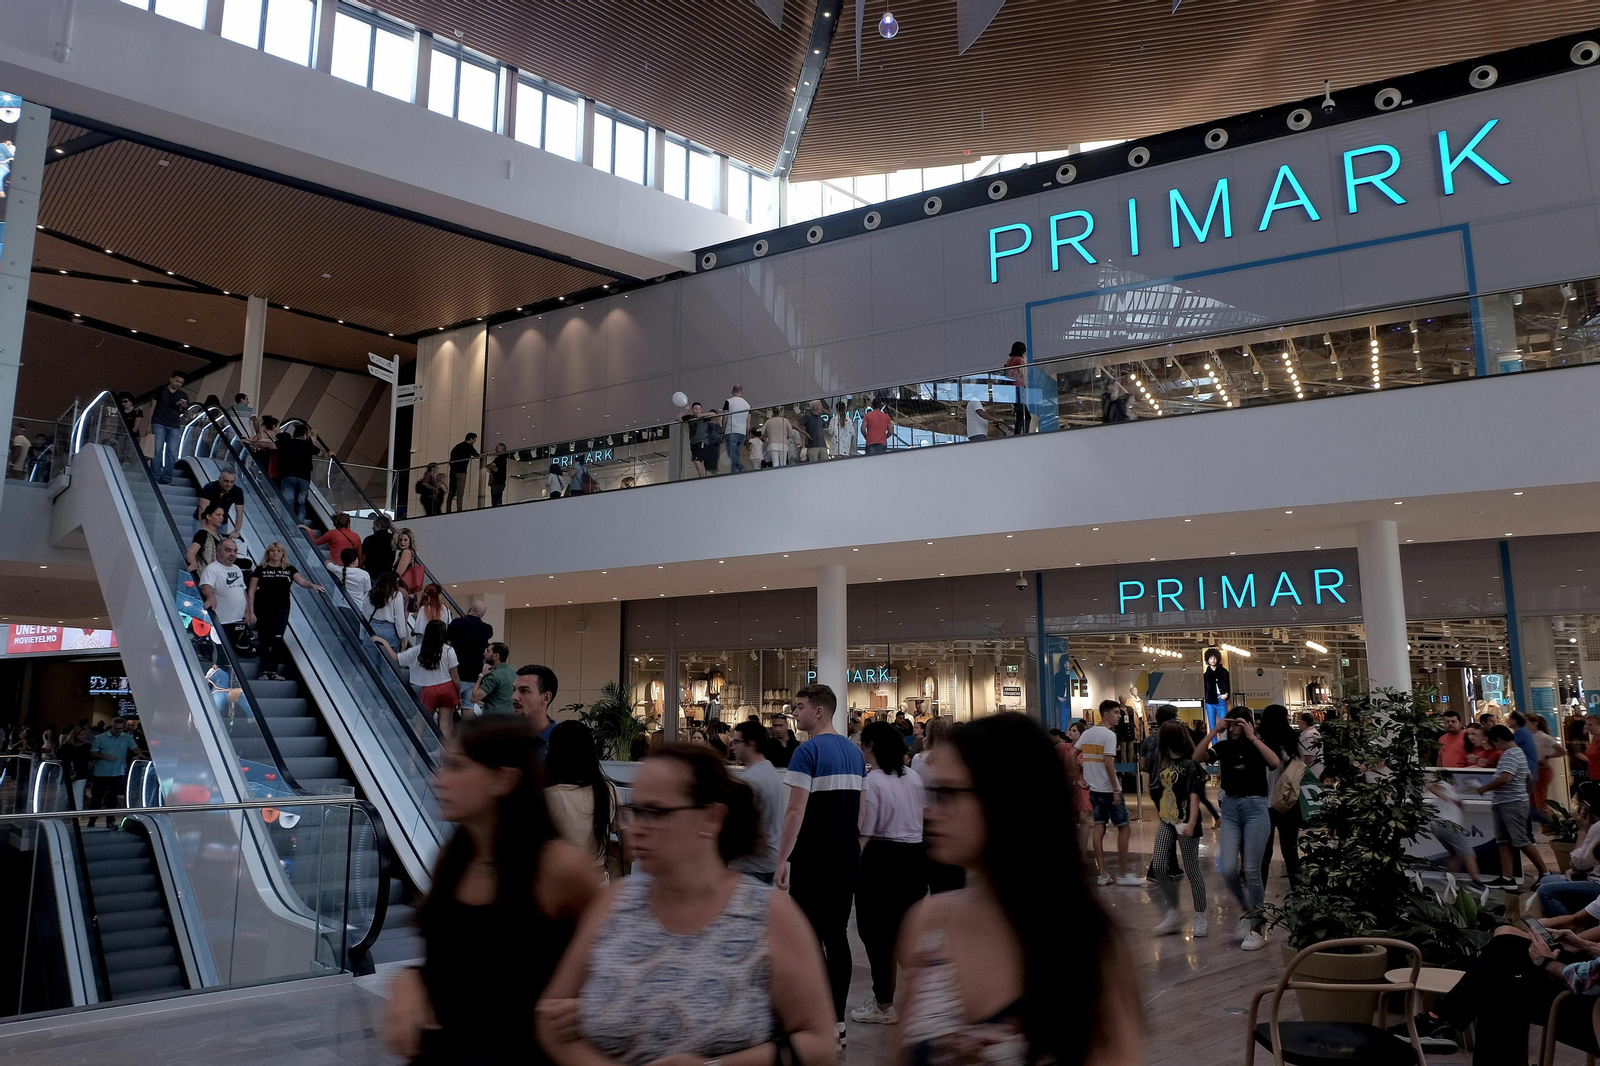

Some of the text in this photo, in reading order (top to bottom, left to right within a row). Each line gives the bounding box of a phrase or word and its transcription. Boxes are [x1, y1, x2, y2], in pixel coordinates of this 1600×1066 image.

[988, 118, 1511, 285] PRIMARK
[552, 447, 614, 468] PRIARK
[1118, 567, 1348, 614] PRIMAR
[14, 634, 57, 645] MOVIEYELMO
[806, 668, 891, 684] PARK
